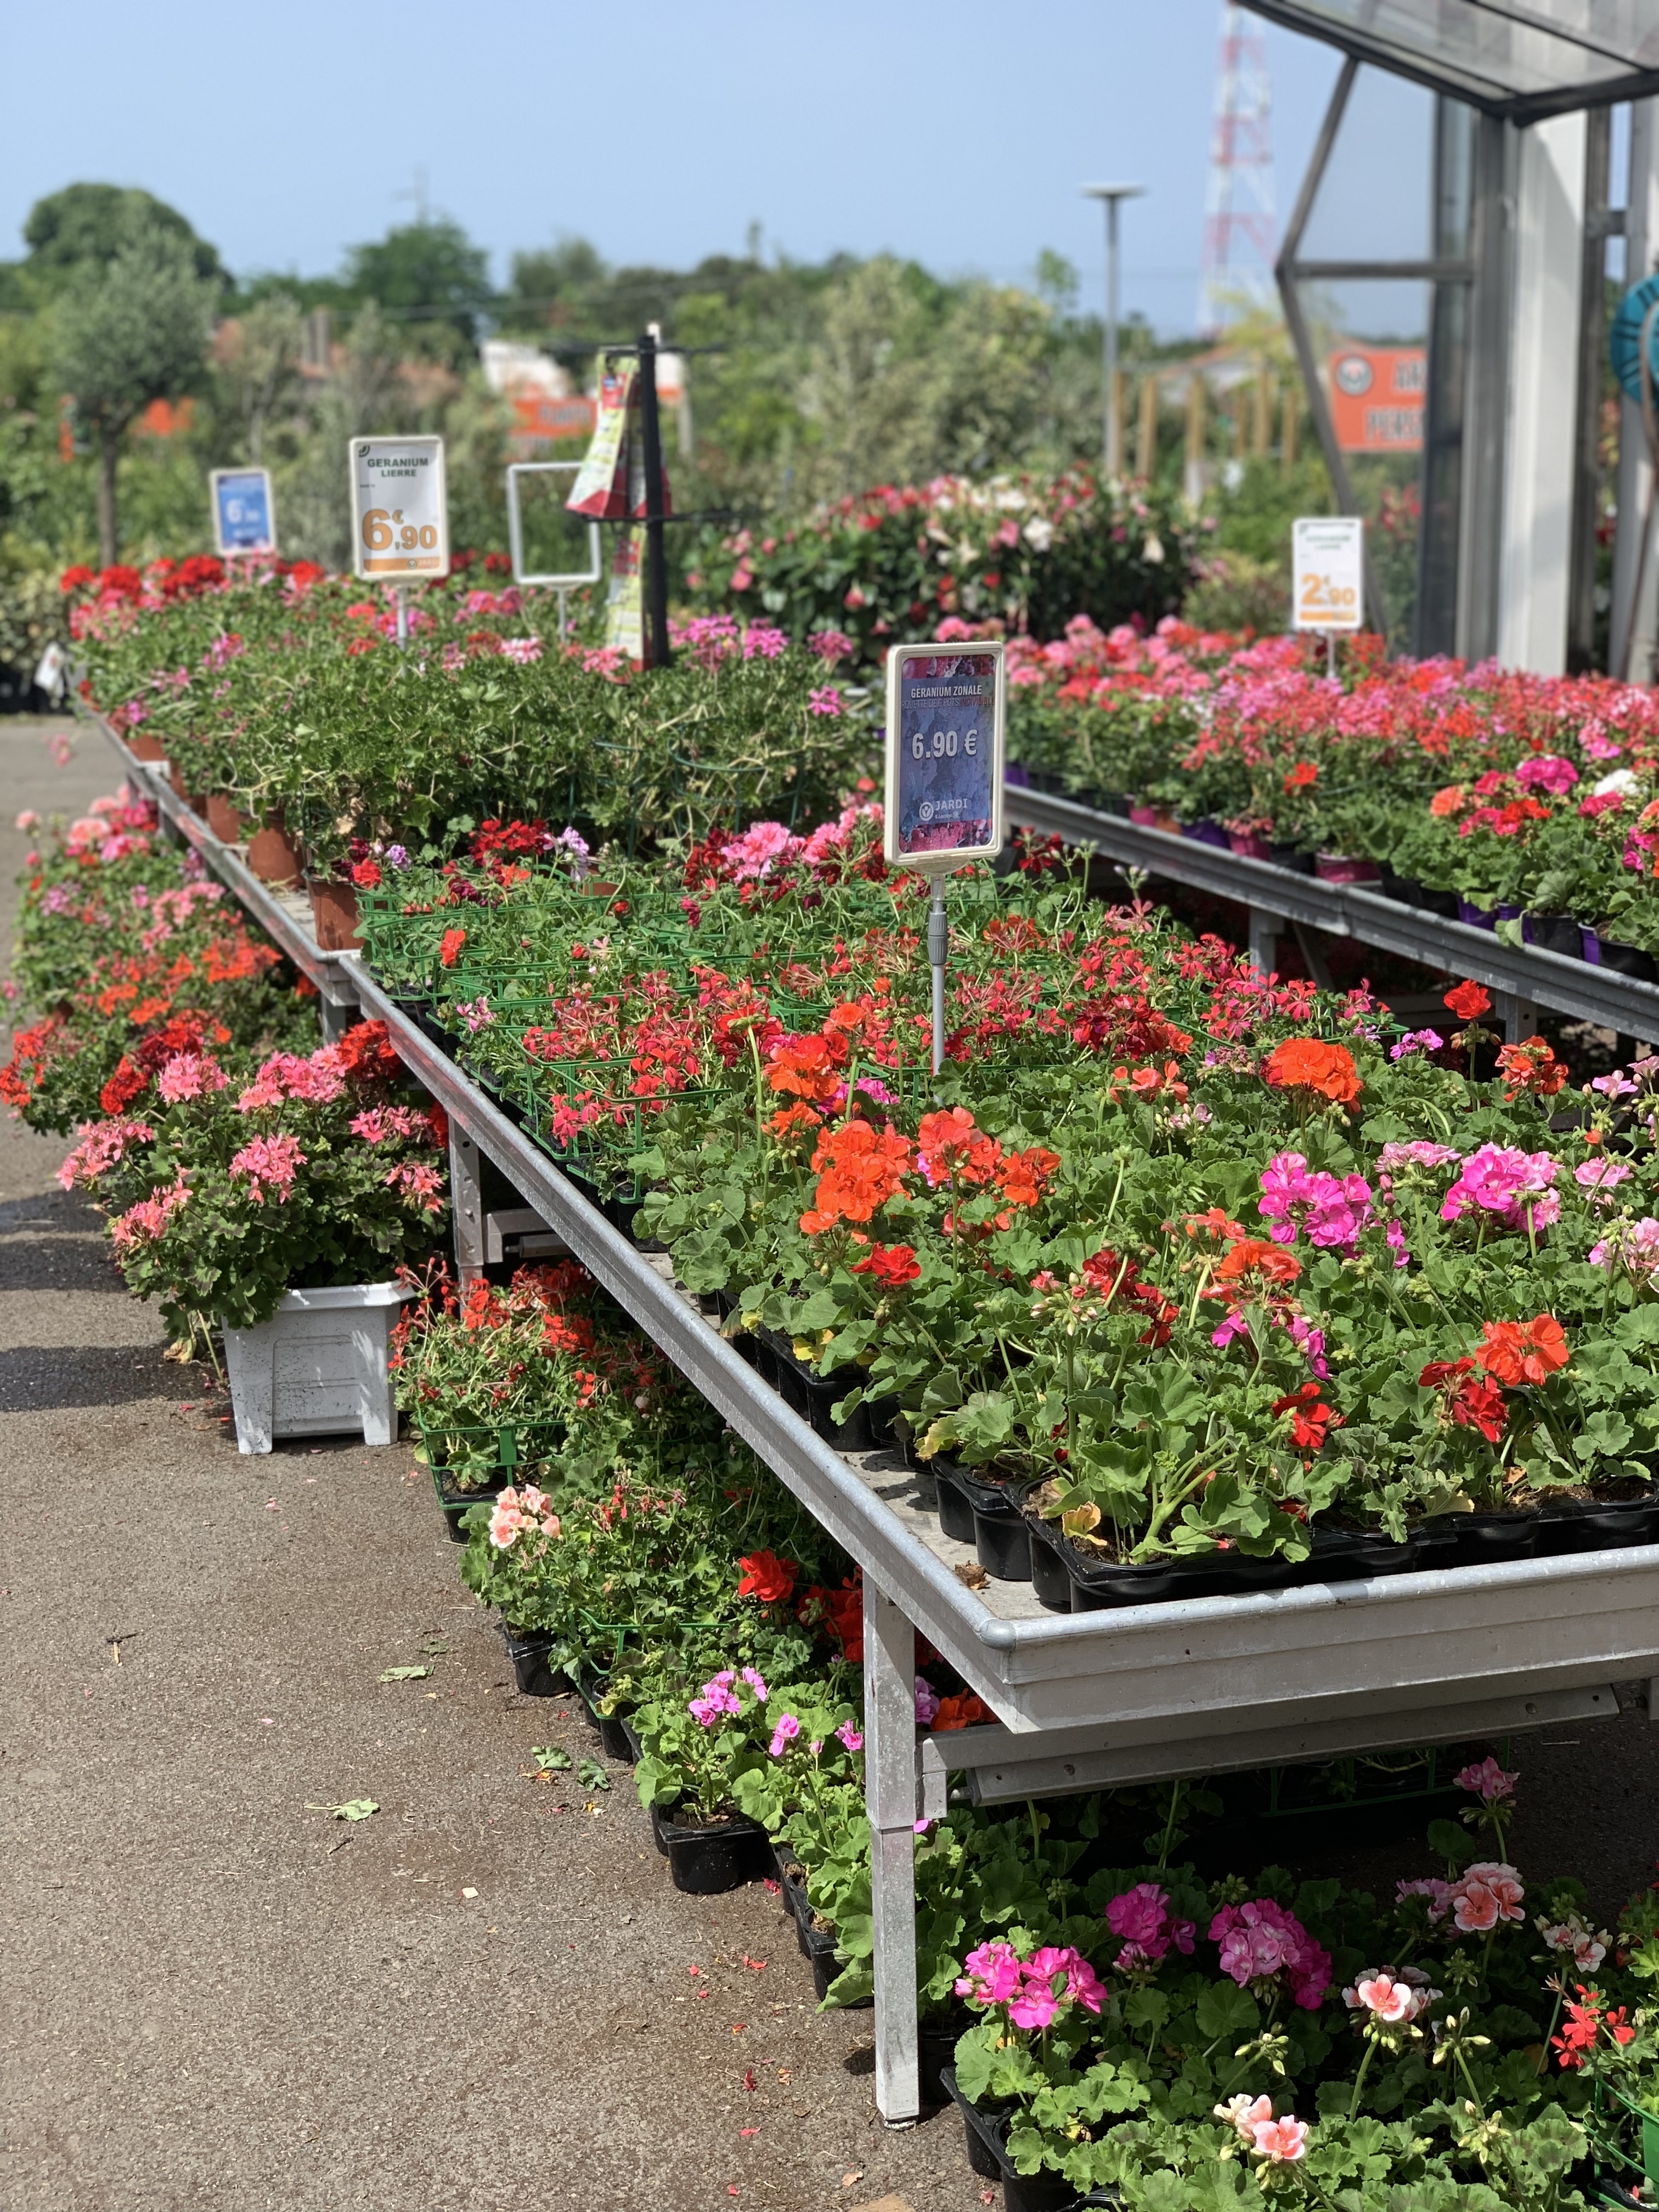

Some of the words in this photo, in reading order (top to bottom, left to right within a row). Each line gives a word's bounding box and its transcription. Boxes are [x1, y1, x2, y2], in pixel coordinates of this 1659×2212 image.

[367, 458, 428, 467] GERANIUM
[381, 469, 417, 477] LIERRE
[911, 686, 951, 698] GÉRANIUM
[953, 685, 982, 696] ZONALE
[929, 699, 937, 708] DE
[938, 698, 942, 708] 6
[943, 697, 959, 707] POTS
[912, 730, 958, 759] 6.90
[964, 729, 978, 755] €
[935, 798, 968, 811] JARDI
